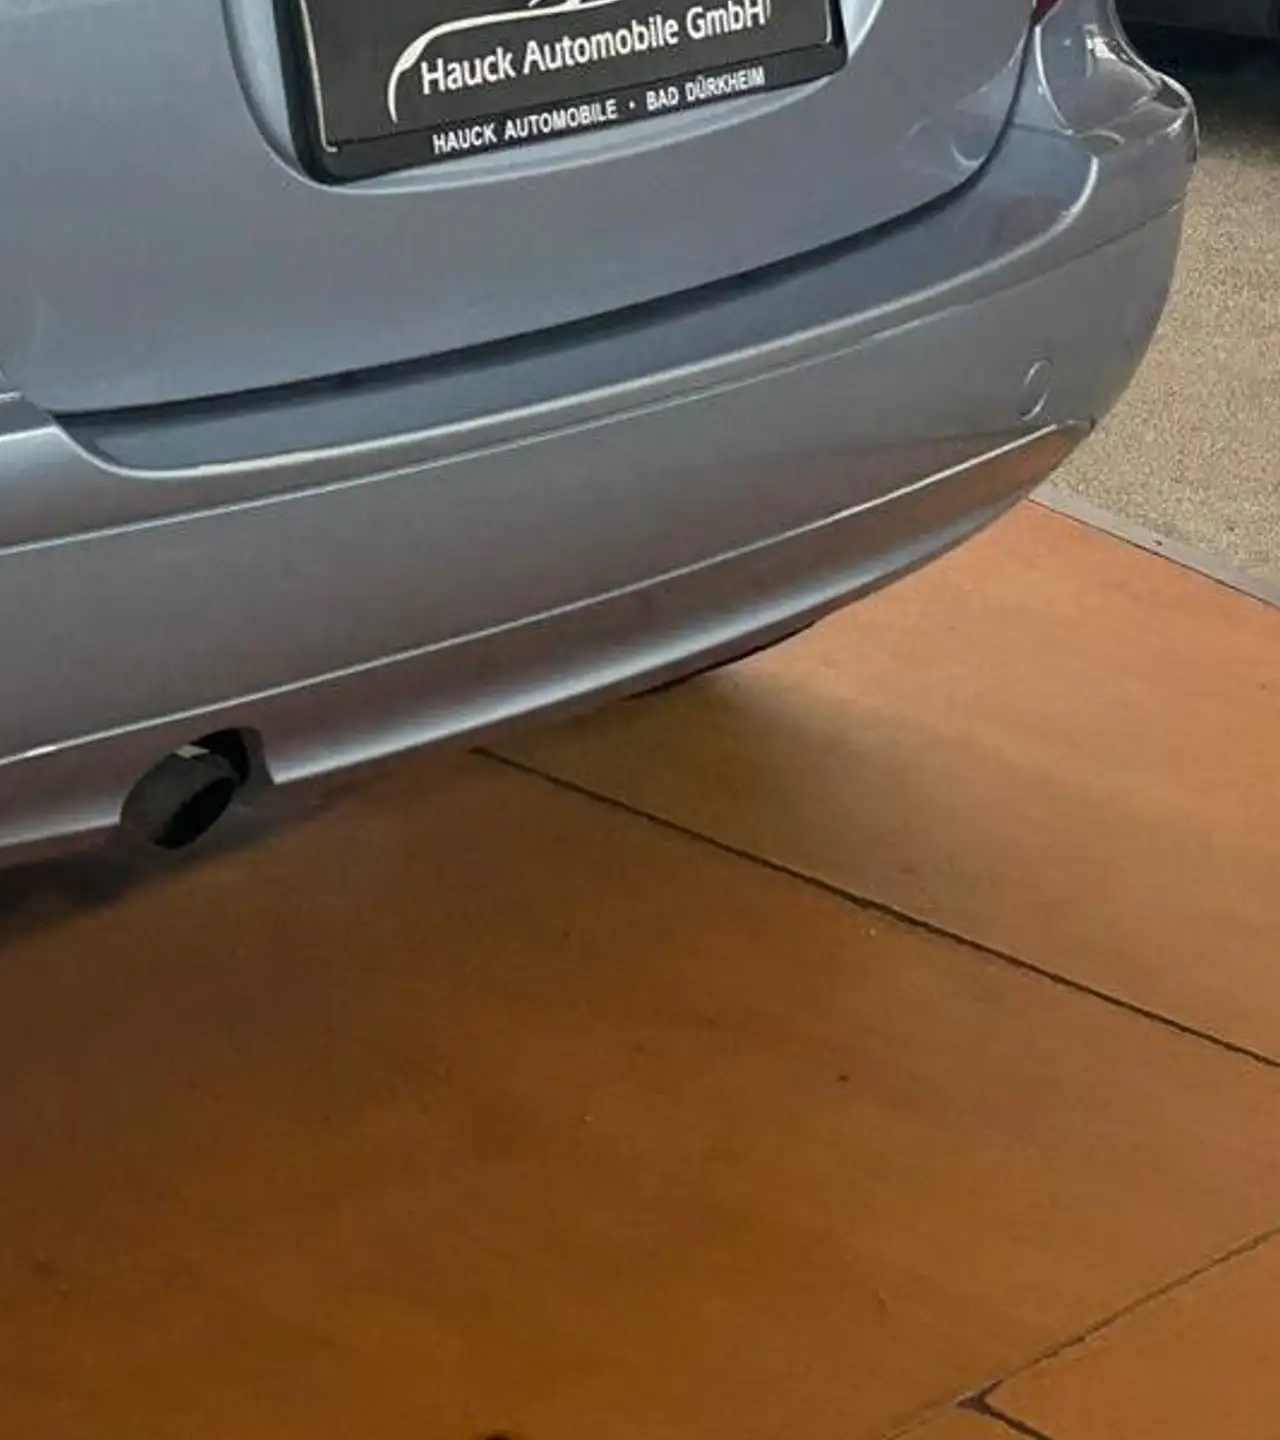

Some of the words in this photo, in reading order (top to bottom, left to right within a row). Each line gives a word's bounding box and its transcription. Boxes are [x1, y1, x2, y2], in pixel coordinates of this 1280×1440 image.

[420, 46, 516, 96] Hauck
[522, 18, 679, 76] Automobile
[432, 124, 497, 155] HAUCK
[503, 98, 618, 141] AUTOMOBILE
[645, 88, 680, 112] BAD
[685, 65, 765, 102] DÜRKHEIM
